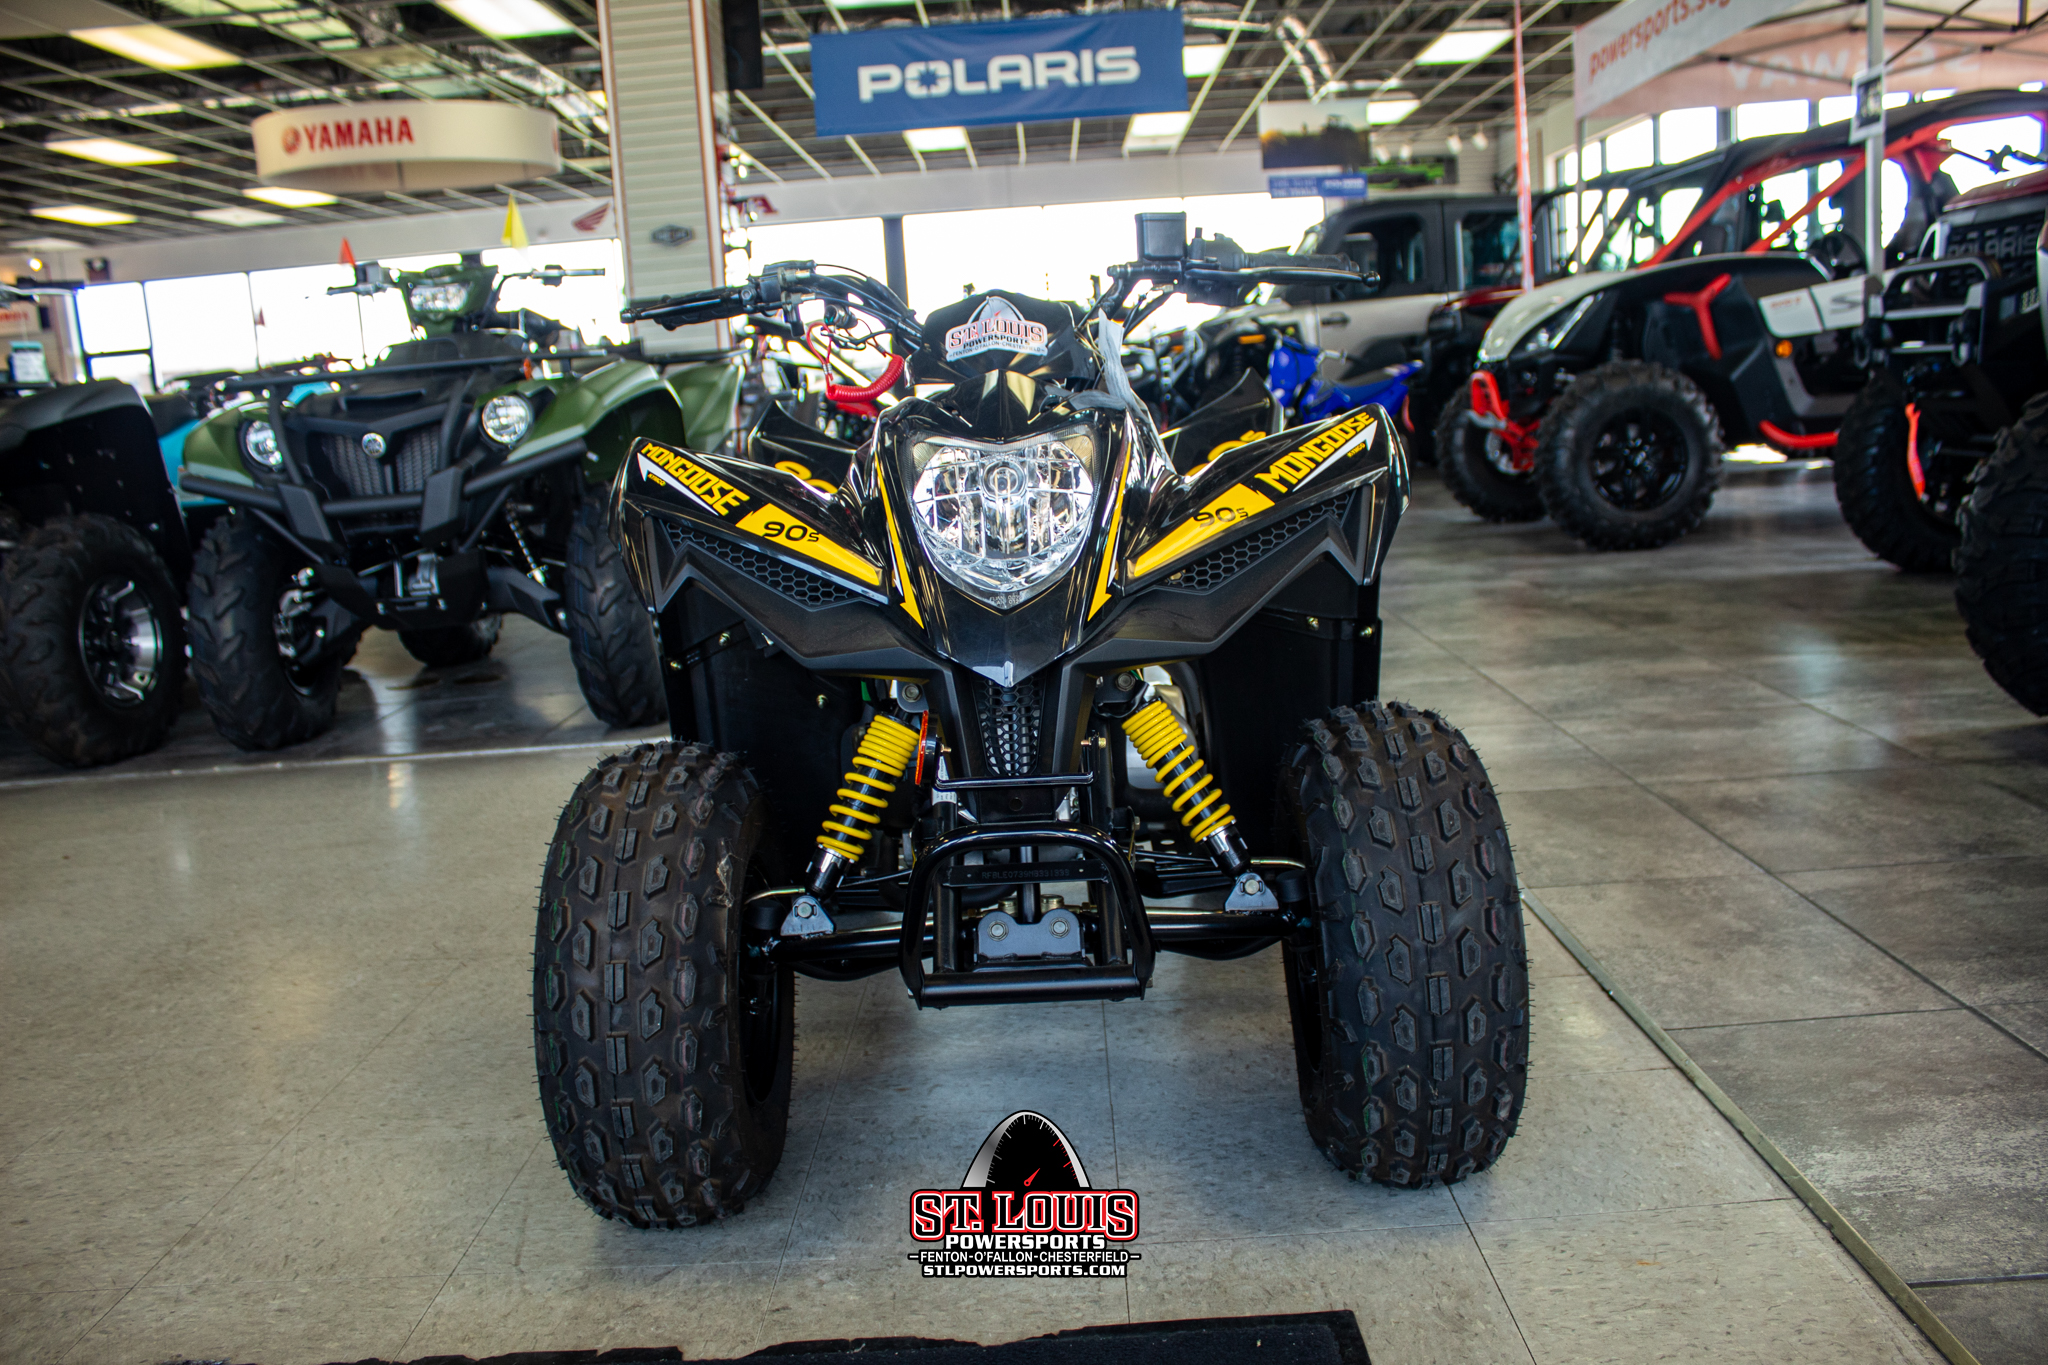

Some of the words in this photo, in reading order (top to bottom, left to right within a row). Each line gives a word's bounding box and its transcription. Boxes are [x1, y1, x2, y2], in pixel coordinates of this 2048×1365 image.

[857, 46, 1141, 103] POLARIS
[303, 115, 415, 152] YAMAHA
[949, 322, 980, 350] ST.
[981, 317, 1044, 344] LOUIS
[962, 334, 1031, 350] POWERSPORTS
[1254, 411, 1375, 494] MONGOOSE
[640, 442, 751, 517] MONGOOSE
